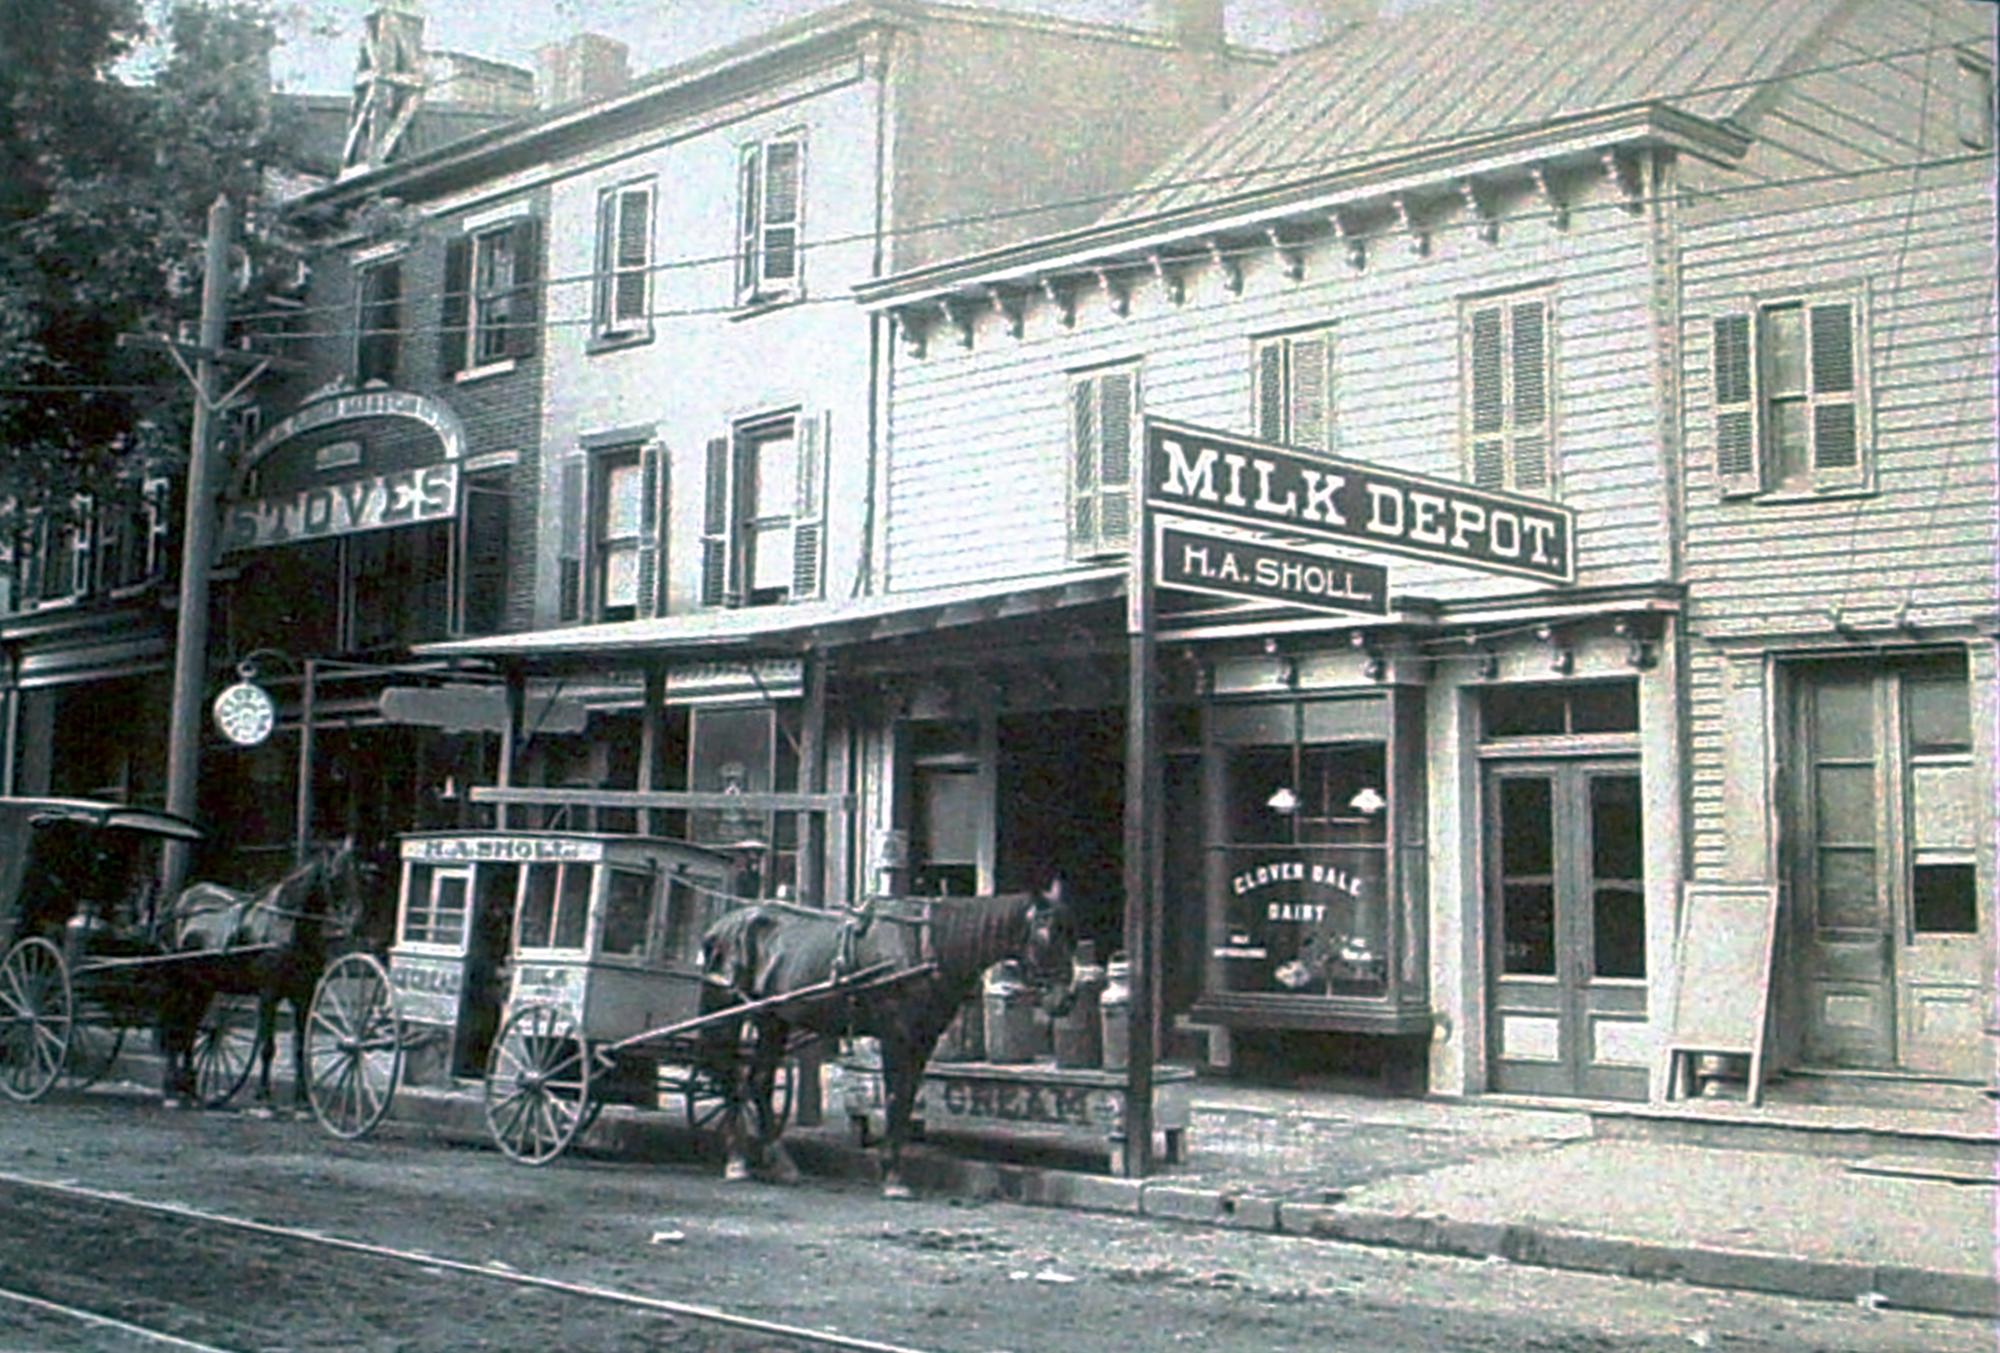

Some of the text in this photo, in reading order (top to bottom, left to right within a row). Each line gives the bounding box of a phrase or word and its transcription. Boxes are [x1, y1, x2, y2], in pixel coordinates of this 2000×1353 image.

[231, 471, 451, 543] STOVES
[1162, 439, 1561, 567] MILK DEPOT.
[1233, 862, 1363, 896] CLOVER DALE
[1267, 902, 1326, 922] DAIRY
